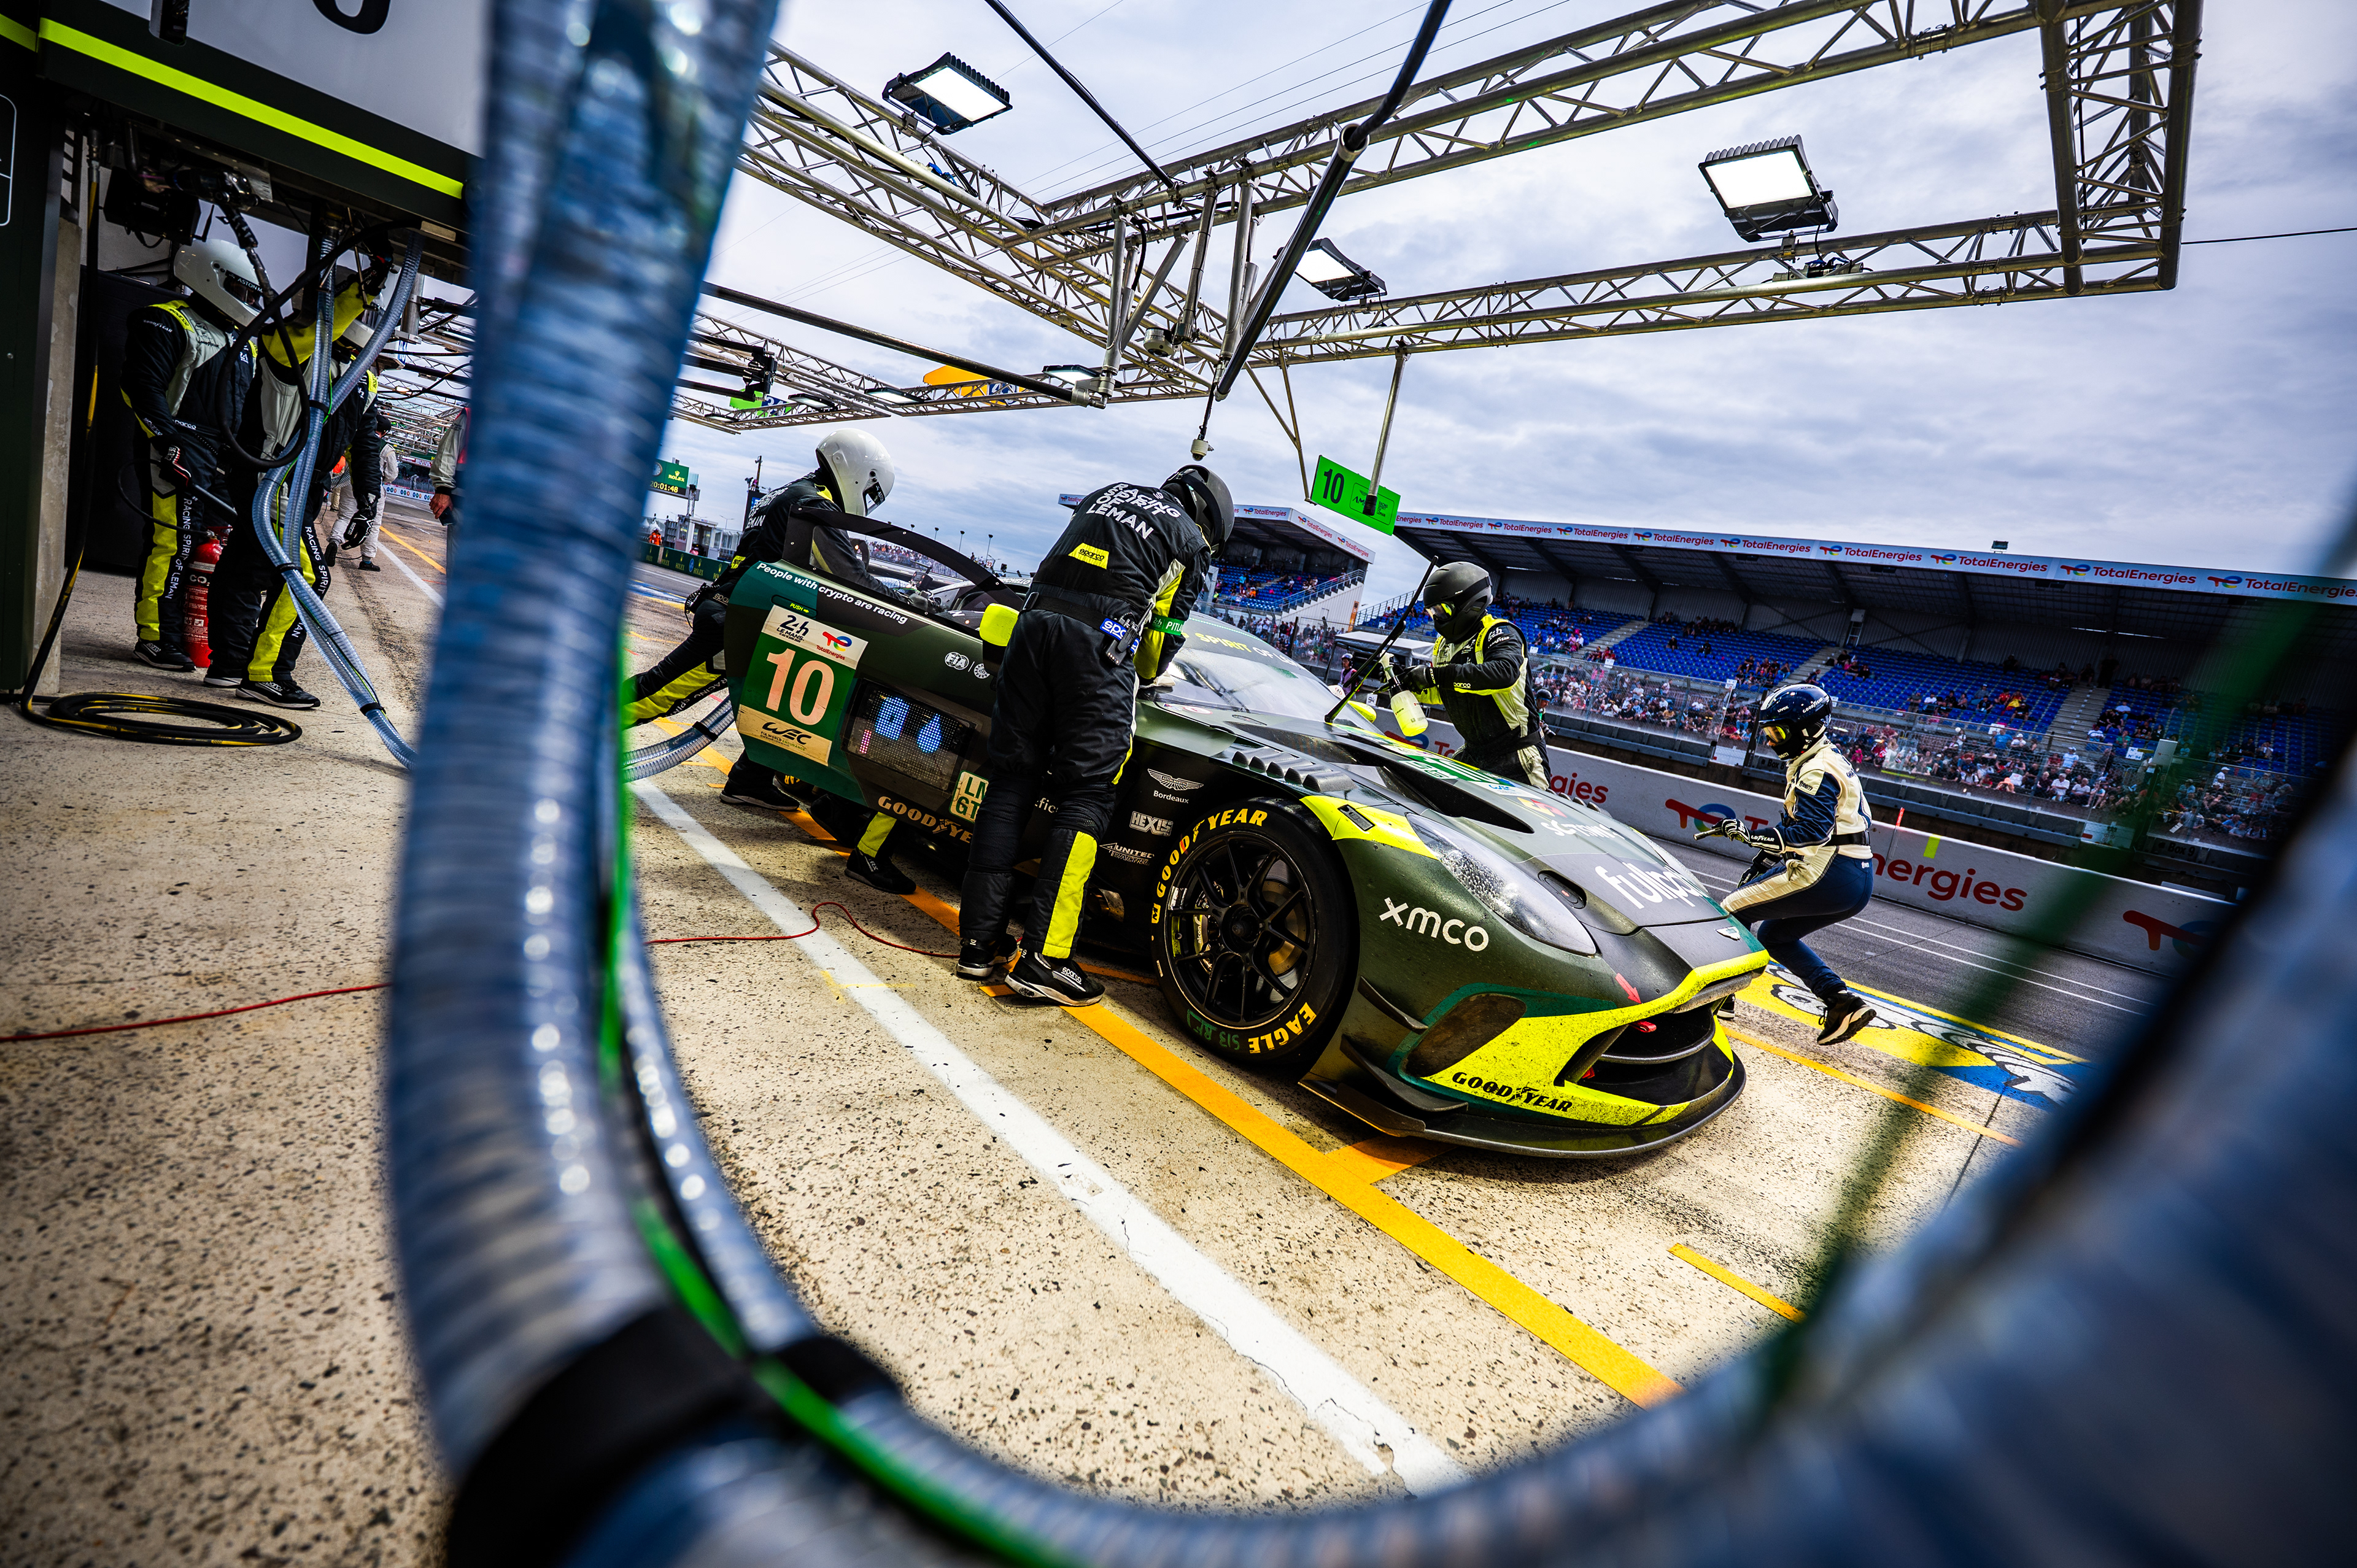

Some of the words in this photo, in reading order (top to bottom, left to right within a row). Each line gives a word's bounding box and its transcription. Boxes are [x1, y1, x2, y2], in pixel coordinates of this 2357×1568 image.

[172, 419, 196, 430] parco
[668, 474, 685, 482] ROLEX
[1323, 468, 1345, 504] 10
[650, 481, 679, 493] 20:01:48
[1096, 495, 1123, 509] OF
[1104, 489, 1166, 516] SPIRIT
[1112, 483, 1182, 518] RACING
[1352, 496, 1366, 506] AM
[184, 498, 192, 530] RACING
[1254, 508, 1287, 517] TotalEnergies
[1396, 515, 1422, 525] Energies
[1086, 503, 1154, 540] LEMAN
[1306, 520, 1333, 539] TotalEnergies
[1439, 518, 1484, 530] TotalEnergies
[1503, 523, 1552, 535] TotalEnergies
[1574, 528, 1628, 540] TotalEnergies
[1652, 533, 1715, 546] TotalEnergies
[1345, 541, 1369, 558] TotalEnergies
[1741, 539, 1811, 553] TotalEnergies
[1844, 546, 1922, 562] TotalEnergies
[305, 526, 322, 562] RACING
[318, 565, 329, 595] SPIRIT
[1078, 547, 1105, 562] sparco
[175, 558, 184, 571] OF
[675, 563, 685, 571] ROLEX
[693, 568, 704, 576] ROLEX
[1958, 555, 2048, 573] TotalEnergies
[2093, 566, 2197, 585] TotalEnergies
[164, 571, 179, 600] LEMAN
[756, 563, 794, 581] People
[793, 576, 818, 590] with
[818, 585, 854, 604] crypto
[854, 598, 873, 610] are
[872, 606, 908, 625] racing
[790, 603, 803, 612] PUSH
[785, 630, 804, 641] MANS
[1194, 632, 1253, 653] SPIRIT
[816, 644, 846, 660] TotalEnergies
[693, 678, 728, 698] RACING
[766, 648, 834, 726] 10
[1802, 697, 1824, 714] GOODYEAR
[762, 722, 812, 745] WEC
[782, 740, 805, 752] ENDURANCE
[1153, 790, 1190, 804] Bordeaux
[1130, 811, 1173, 834] HEXIS
[1156, 808, 1268, 898] GOODYEAR
[2167, 841, 2188, 856] Box
[2188, 846, 2196, 857] 9
[1379, 896, 1490, 952] xmco
[1061, 967, 1082, 985] sparco
[1247, 1002, 1317, 1054] EAGLE
[1452, 1072, 1573, 1113] GOODYEAR
